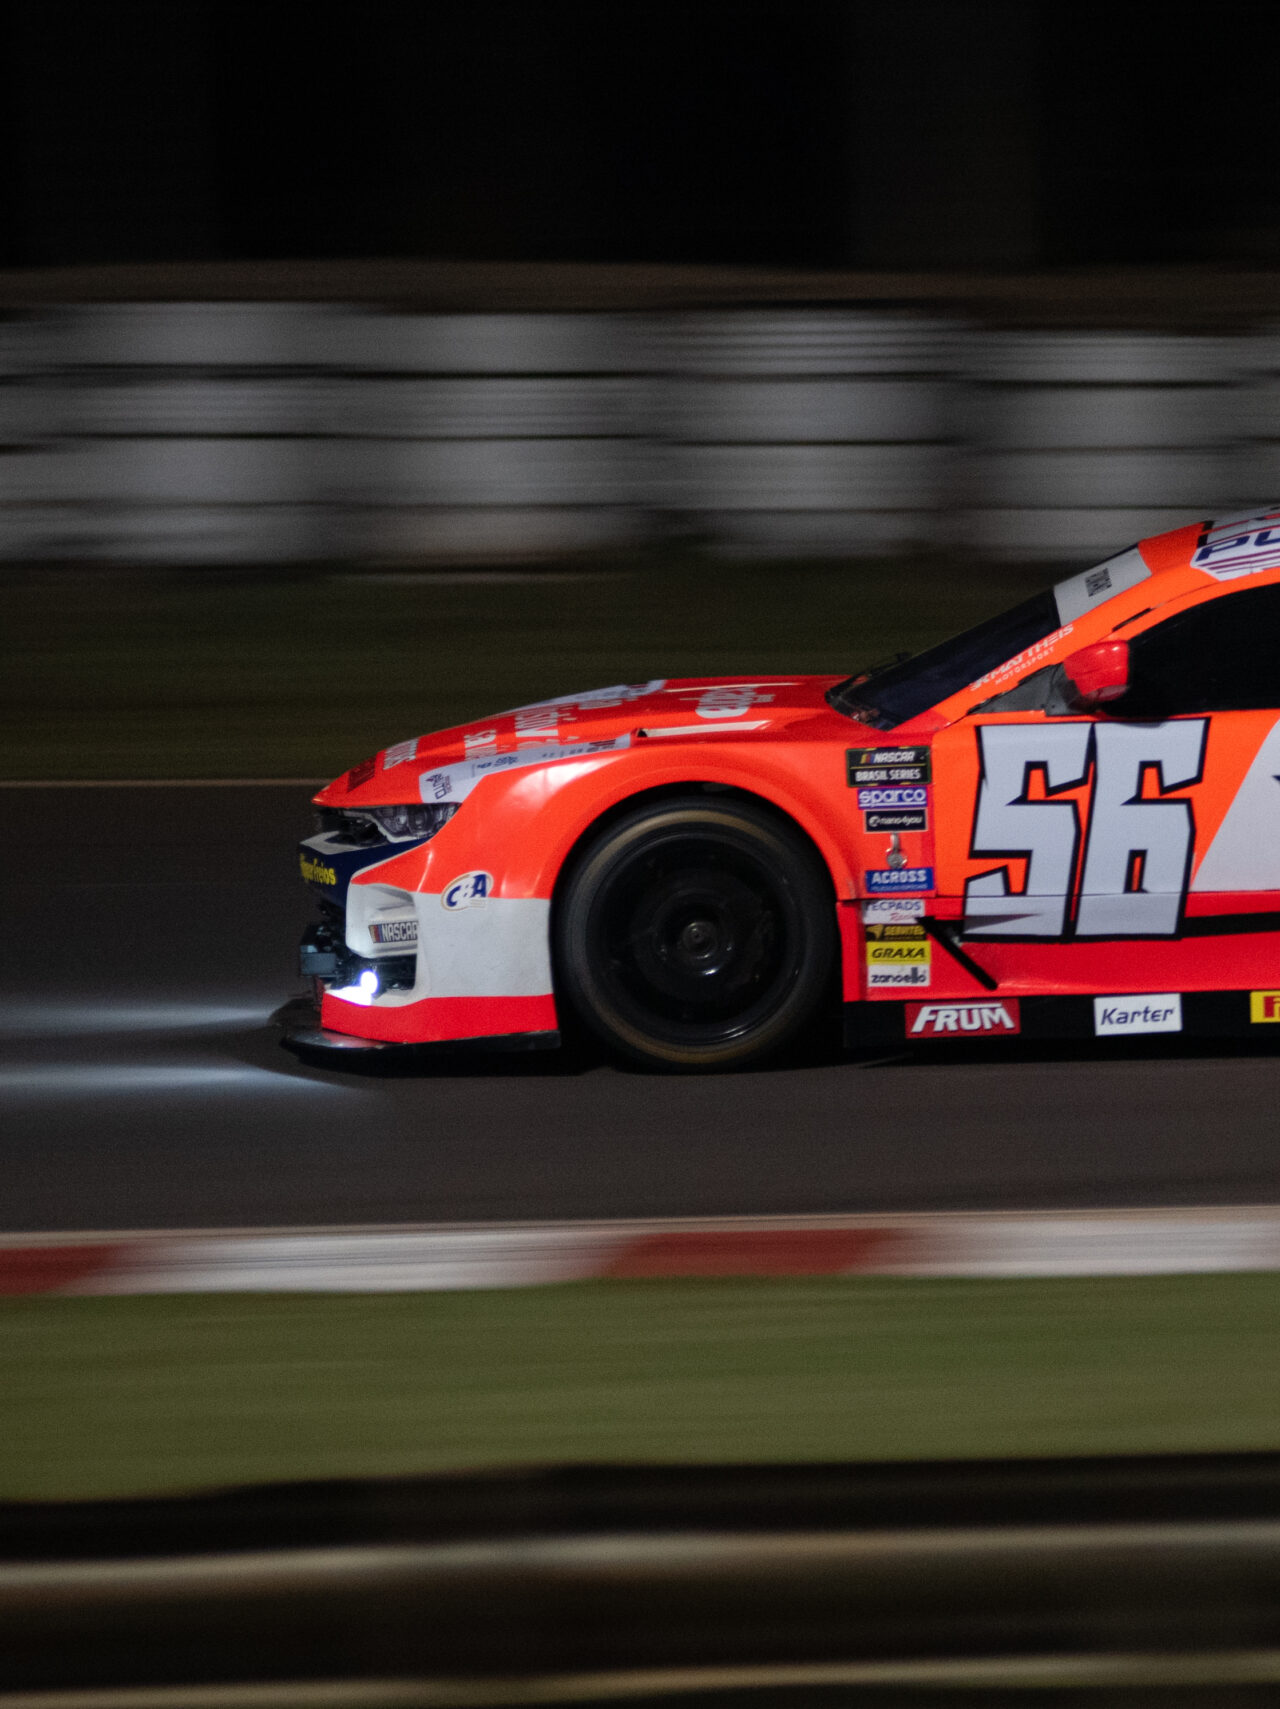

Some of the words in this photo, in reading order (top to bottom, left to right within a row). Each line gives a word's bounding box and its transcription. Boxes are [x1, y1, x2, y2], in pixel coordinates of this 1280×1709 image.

[995, 646, 1055, 685] MOTORSPORT
[873, 751, 916, 764] NASCAR
[855, 769, 888, 782] BRASIL
[889, 768, 921, 780] SERIES
[858, 789, 927, 807] sparco
[960, 717, 1211, 943] 56
[871, 870, 928, 885] ACROSS
[871, 947, 926, 959] GRAXA
[911, 1003, 1015, 1033] FRUM
[1101, 1006, 1175, 1026] Karter
